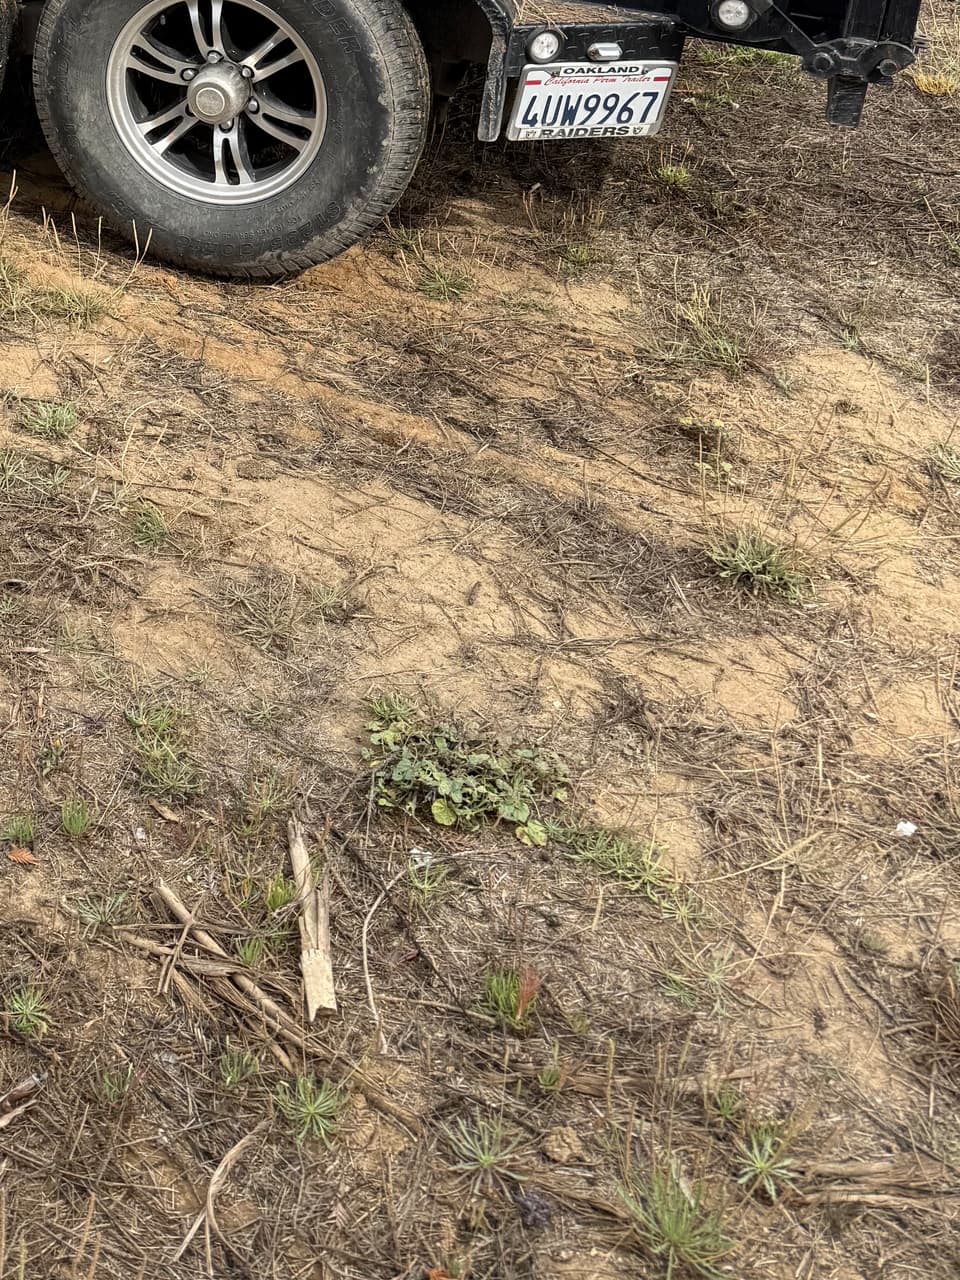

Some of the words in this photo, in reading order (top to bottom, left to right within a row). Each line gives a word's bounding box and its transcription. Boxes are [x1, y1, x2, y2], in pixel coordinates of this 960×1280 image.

[562, 66, 641, 75] OAKLAND
[543, 76, 590, 87] California
[521, 91, 660, 128] 4UW9967
[538, 126, 631, 139] RAIDERS
